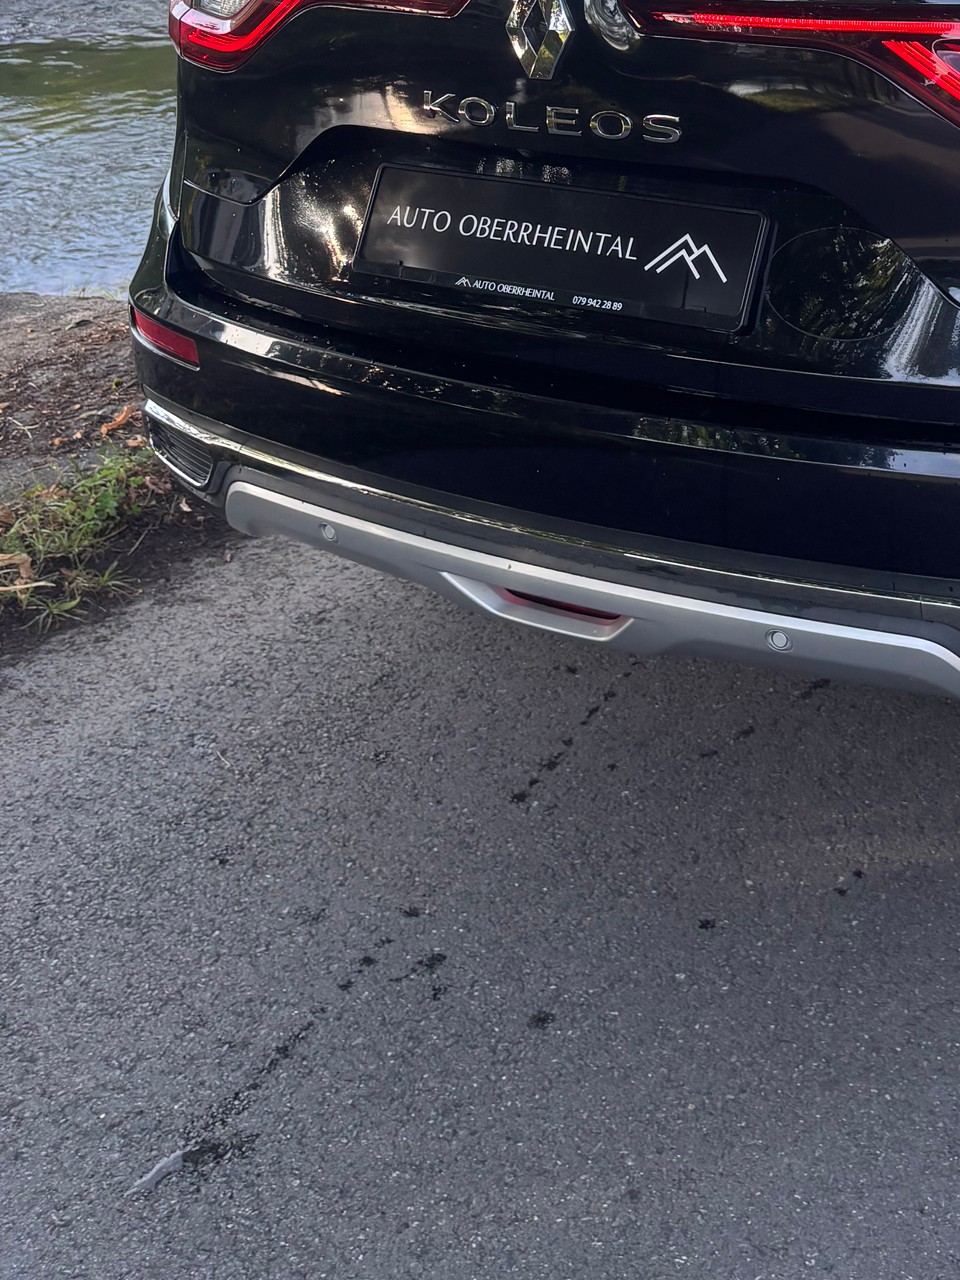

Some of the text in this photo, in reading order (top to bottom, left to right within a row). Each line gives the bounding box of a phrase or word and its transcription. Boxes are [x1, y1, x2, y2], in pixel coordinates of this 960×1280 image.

[423, 90, 682, 144] KOLEOS
[387, 205, 637, 260] AUTO OBERRHEINTAL
[472, 280, 556, 301] AUTO OBERRHEINTAL
[572, 295, 623, 311] 079 942 28 89
